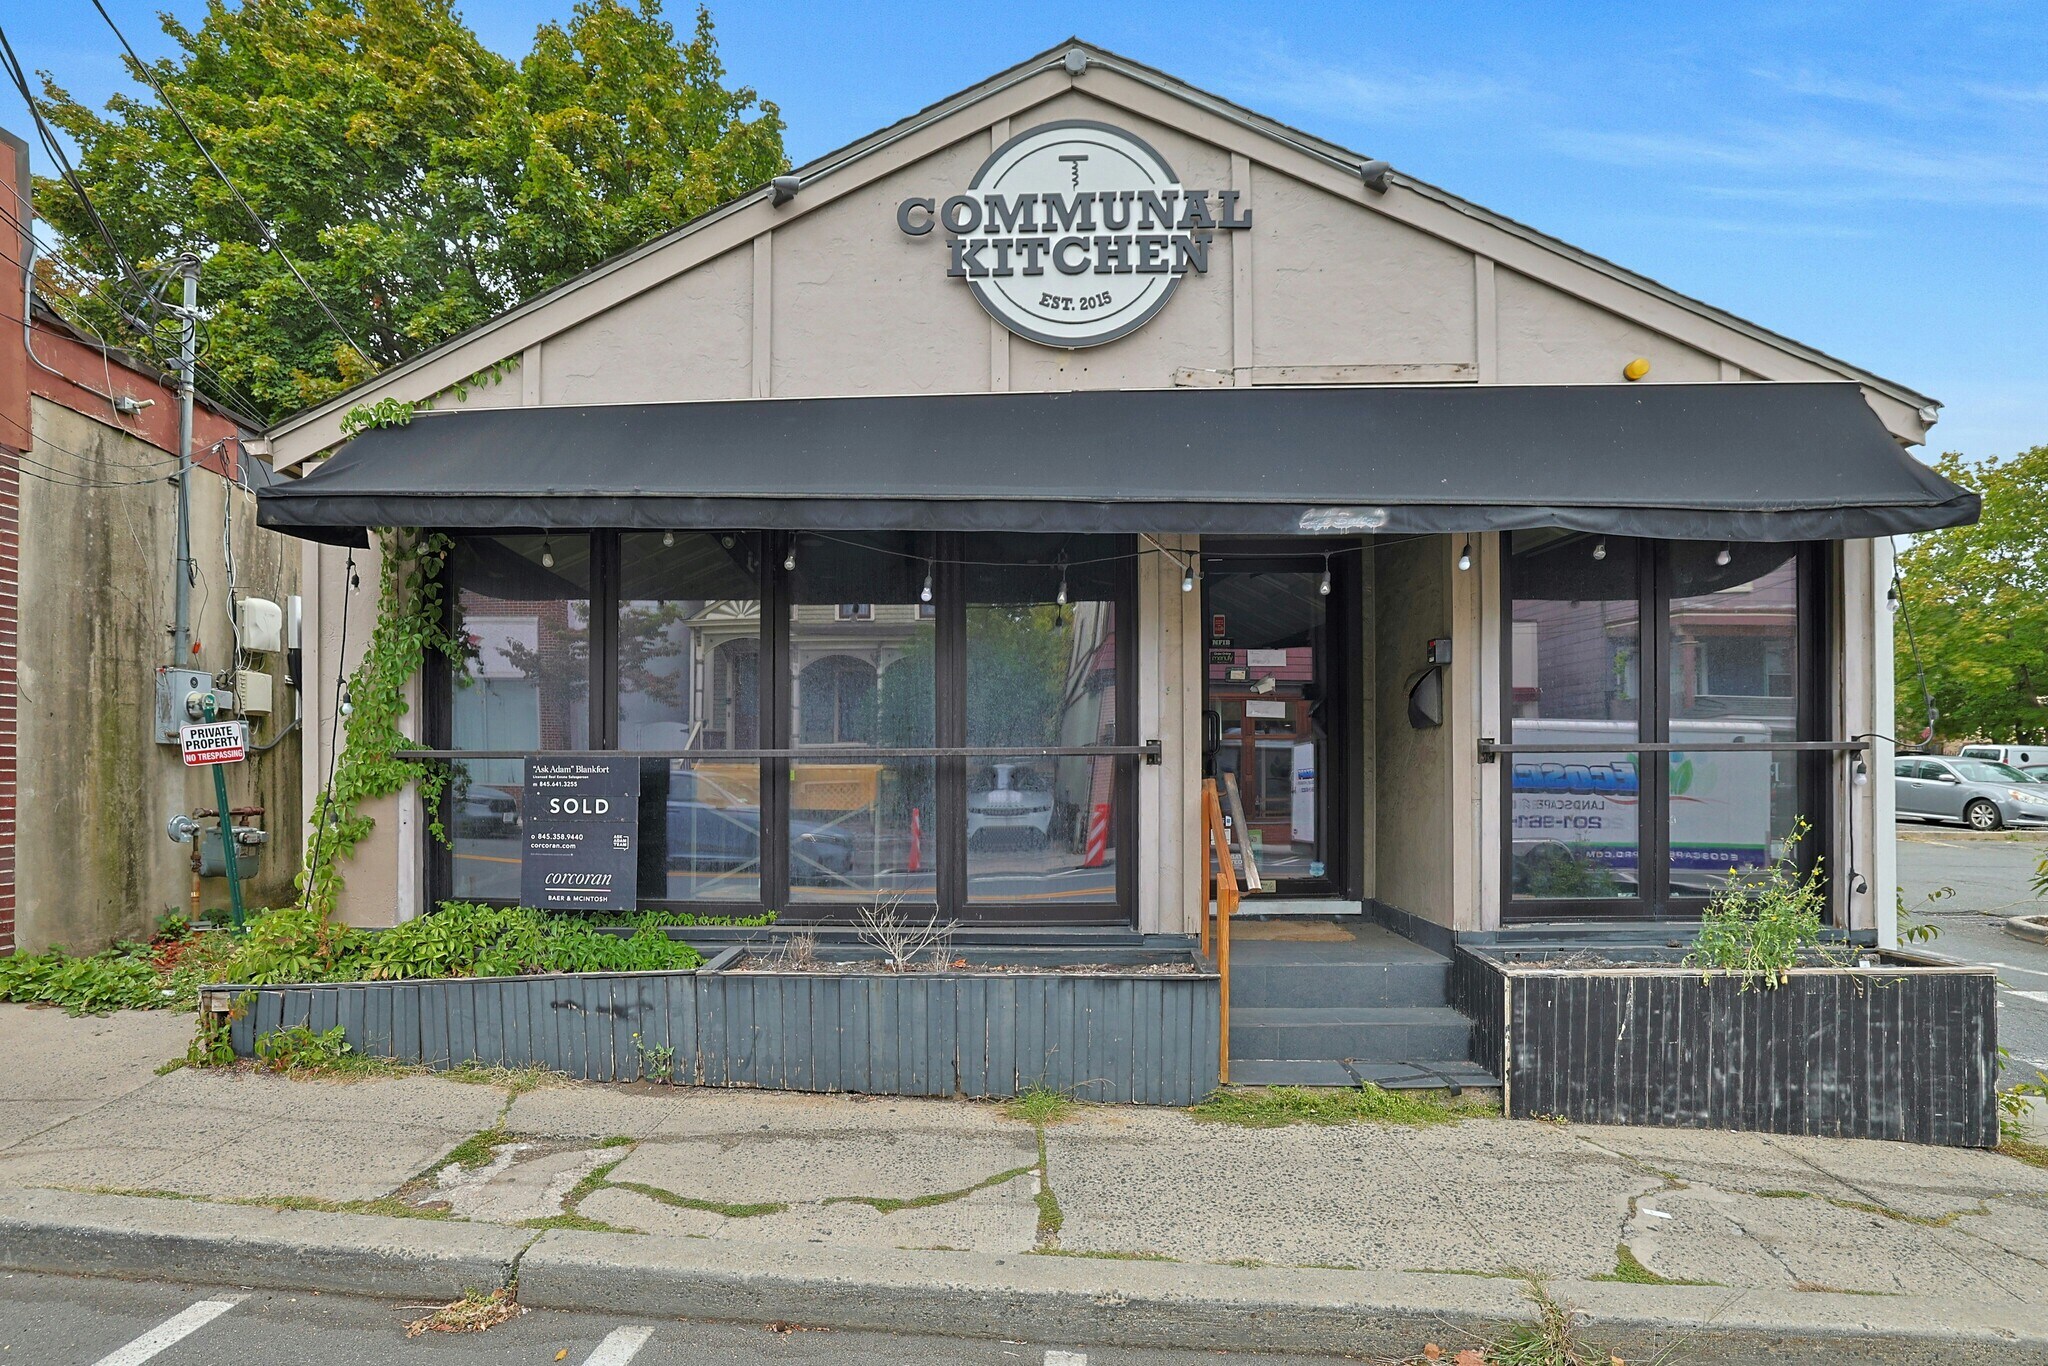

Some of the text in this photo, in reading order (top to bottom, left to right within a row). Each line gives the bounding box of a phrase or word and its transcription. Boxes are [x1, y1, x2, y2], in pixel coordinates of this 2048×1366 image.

[896, 189, 1253, 236] COMMUNAL
[946, 233, 1213, 278] KITCHEN
[1039, 290, 1113, 312] EST. 2015
[190, 726, 232, 739] PRIVATE
[186, 736, 239, 750] PROPERTY
[186, 750, 243, 762] NO TRESPASSING
[575, 765, 610, 774] Blankfort
[550, 798, 609, 814] SOLD
[537, 833, 584, 841] 845.358.9440
[544, 872, 612, 886] corcoran
